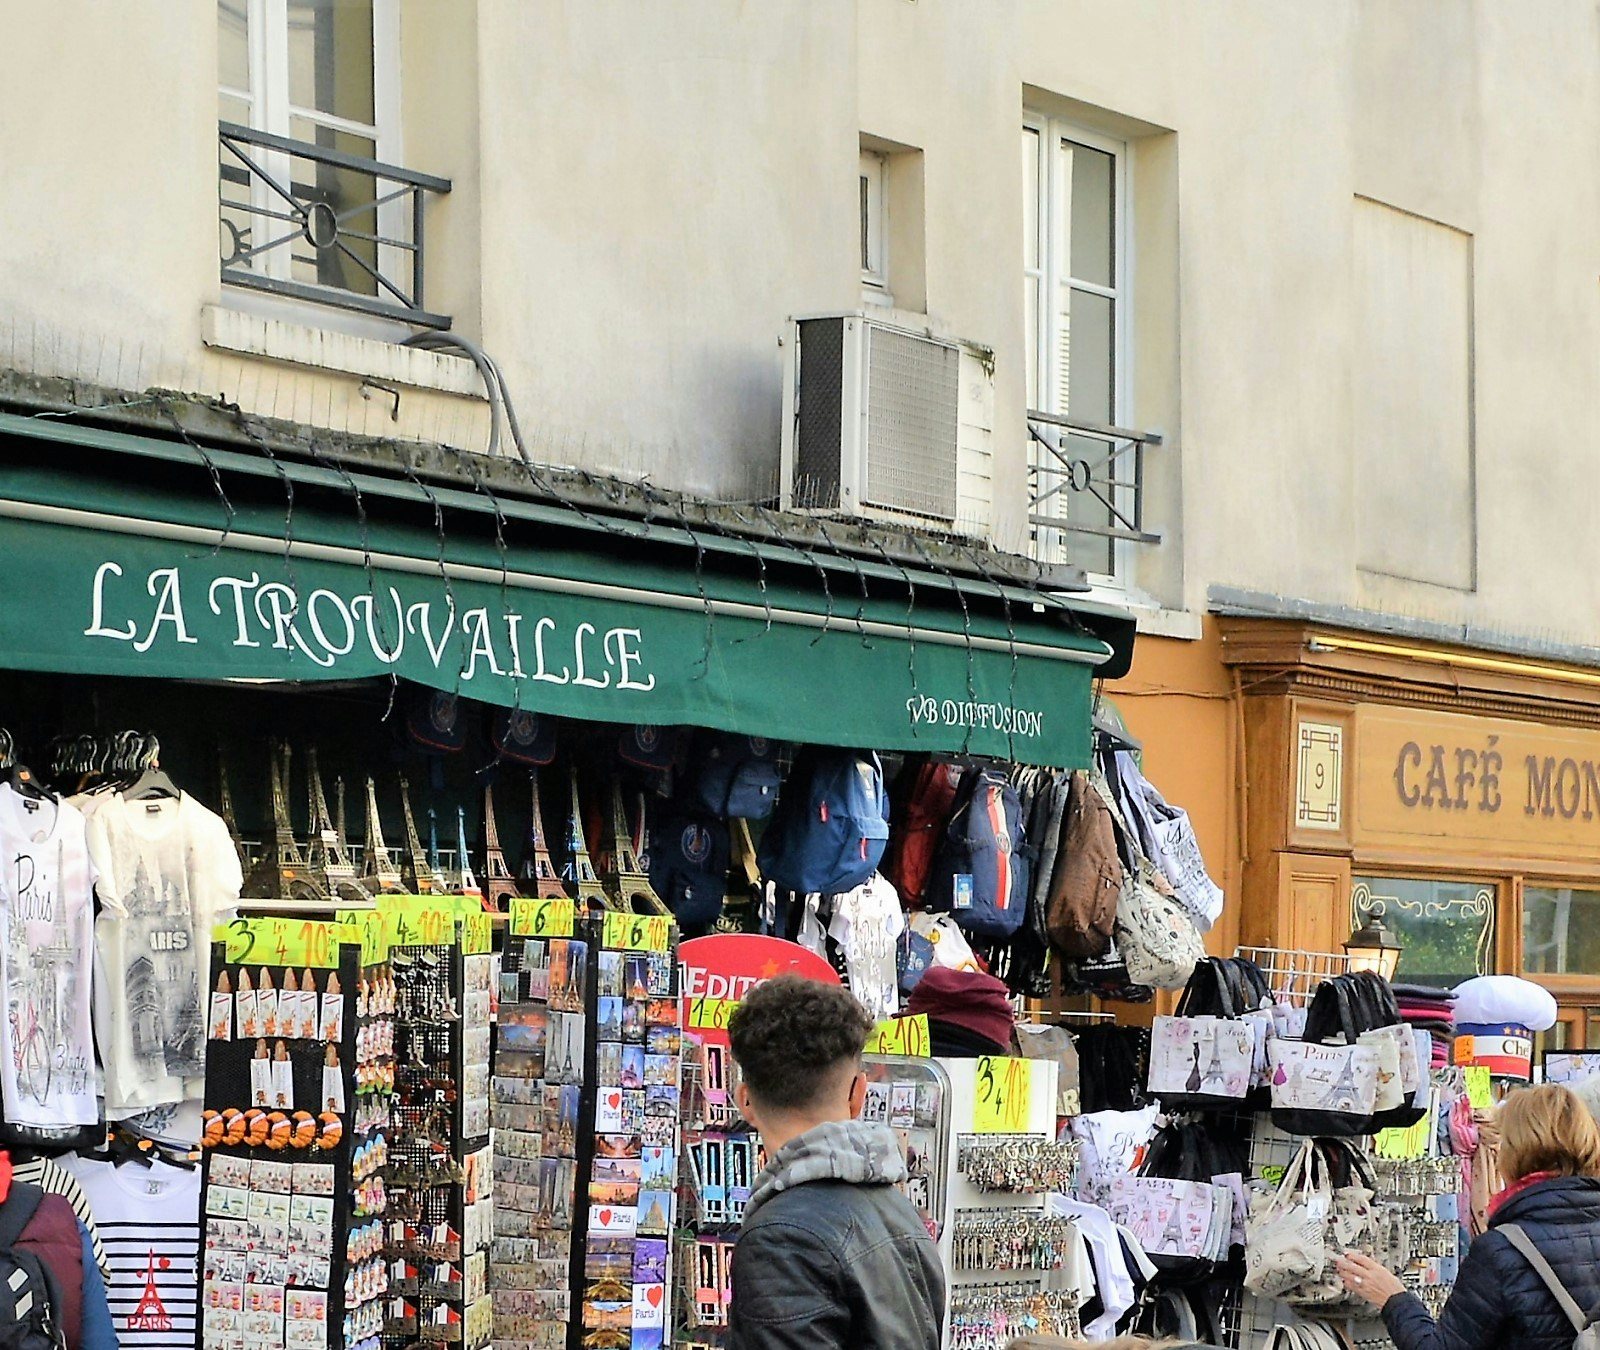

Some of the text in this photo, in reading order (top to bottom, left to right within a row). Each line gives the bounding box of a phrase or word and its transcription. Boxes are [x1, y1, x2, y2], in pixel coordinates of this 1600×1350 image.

[83, 561, 656, 692] LA TROUVAILLE
[941, 698, 1043, 737] DIFFUSION
[1314, 762, 1326, 790] 9
[1395, 735, 1503, 813] CAFÉ
[14, 852, 53, 923] Paris
[686, 966, 771, 1001] EDIT
[1303, 1045, 1345, 1061] Paris
[613, 1212, 632, 1223] Paris
[127, 1314, 173, 1331] PARIS
[635, 1308, 656, 1319] Paris
